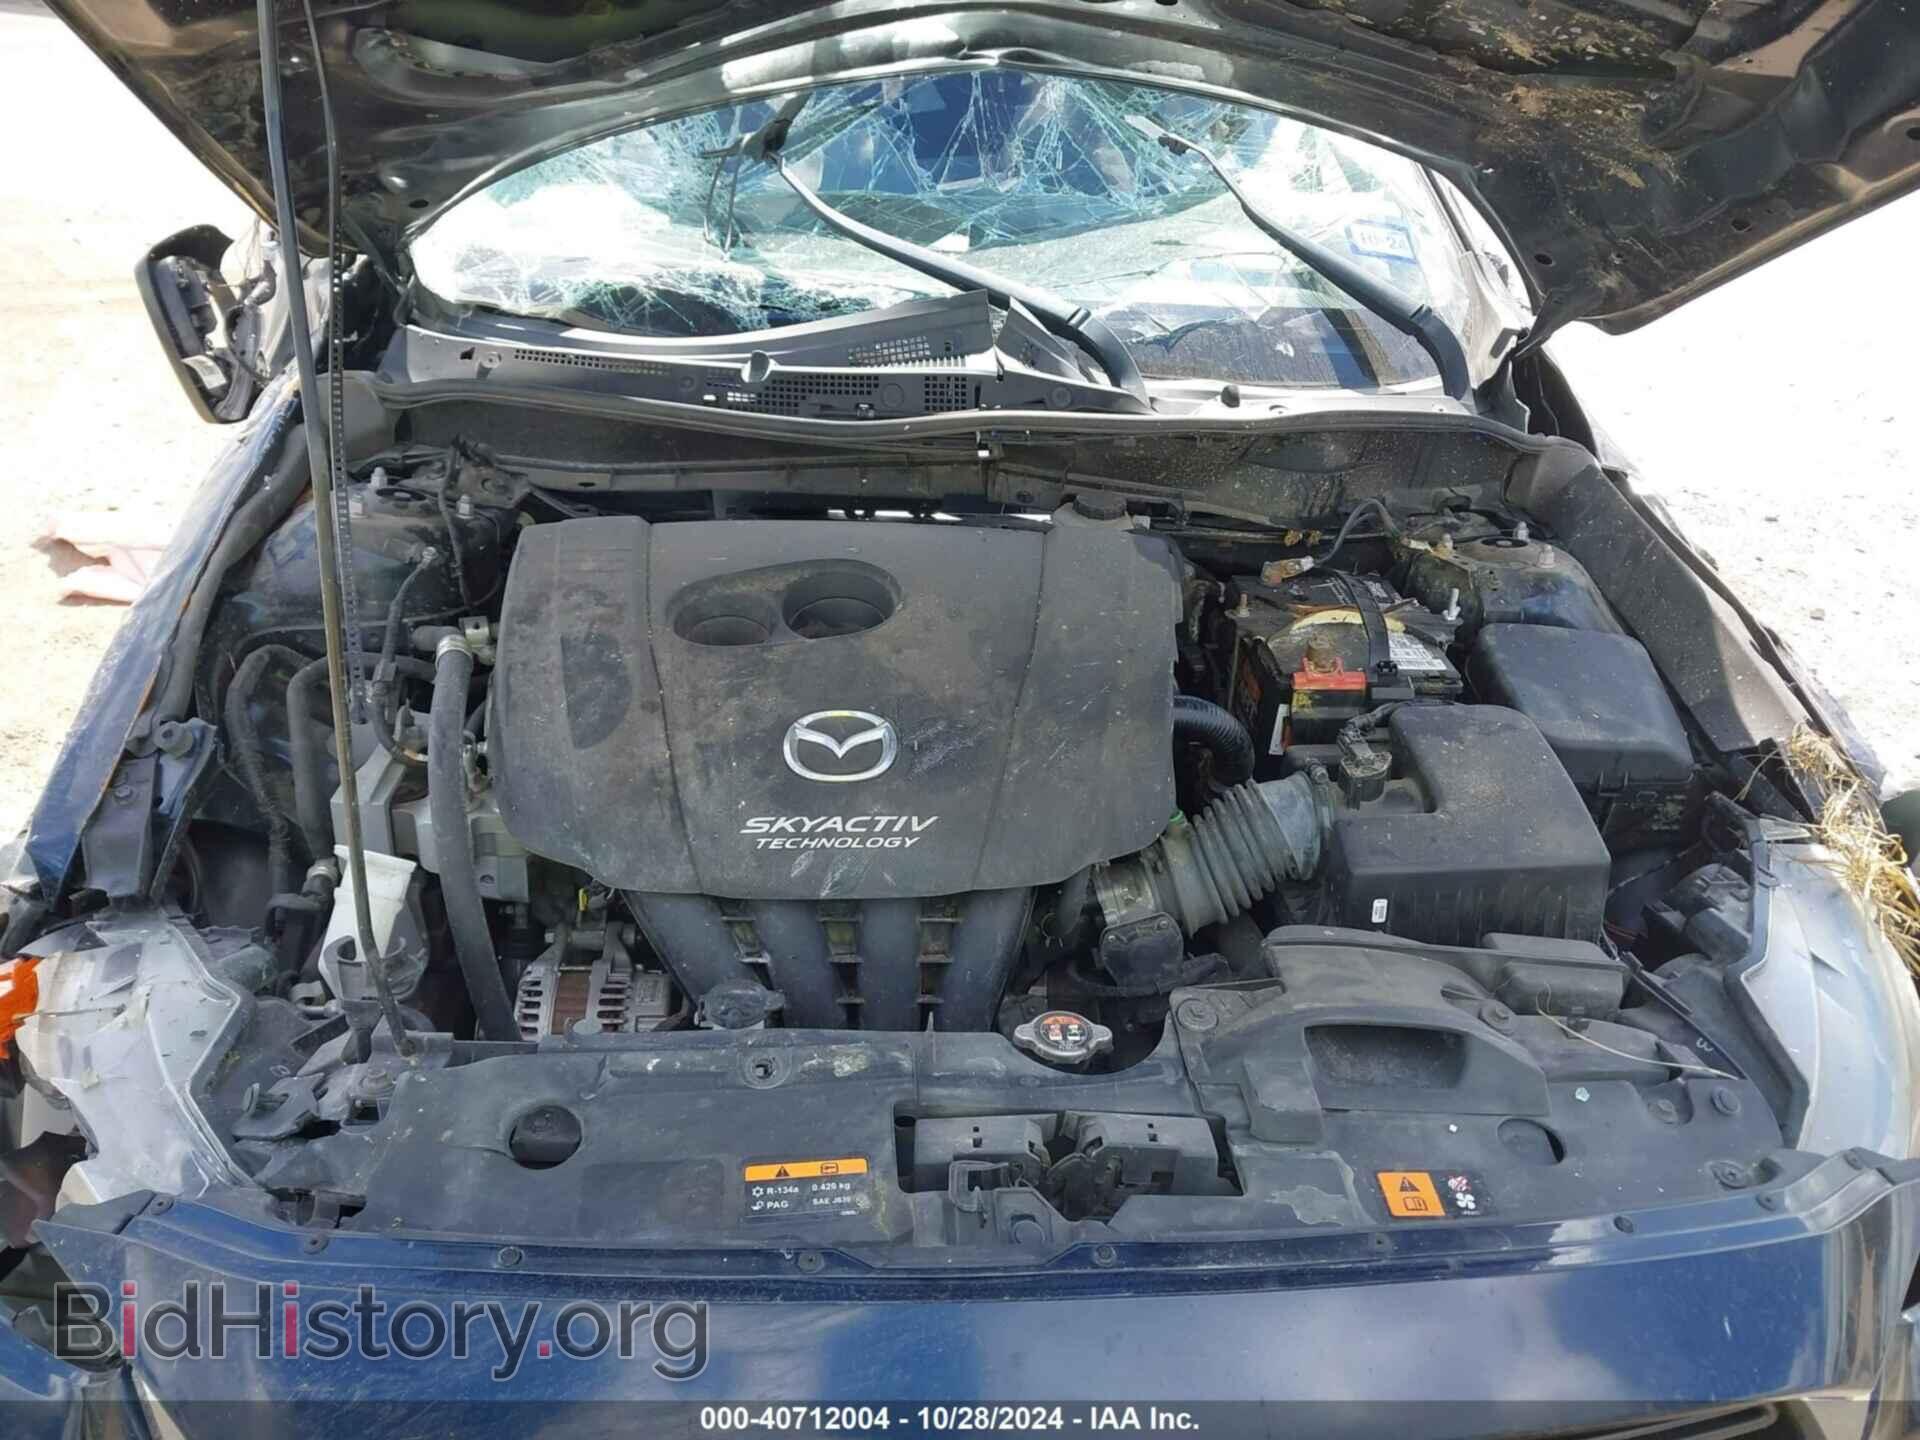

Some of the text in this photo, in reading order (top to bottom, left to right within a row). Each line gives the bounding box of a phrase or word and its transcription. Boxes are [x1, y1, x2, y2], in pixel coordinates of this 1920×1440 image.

[740, 816, 940, 834] SKYACTIV
[755, 837, 921, 849] TECHNOLOGY
[766, 1185, 800, 1195] R-134a
[766, 1200, 789, 1210] PAG
[812, 1197, 830, 1206] SAE
